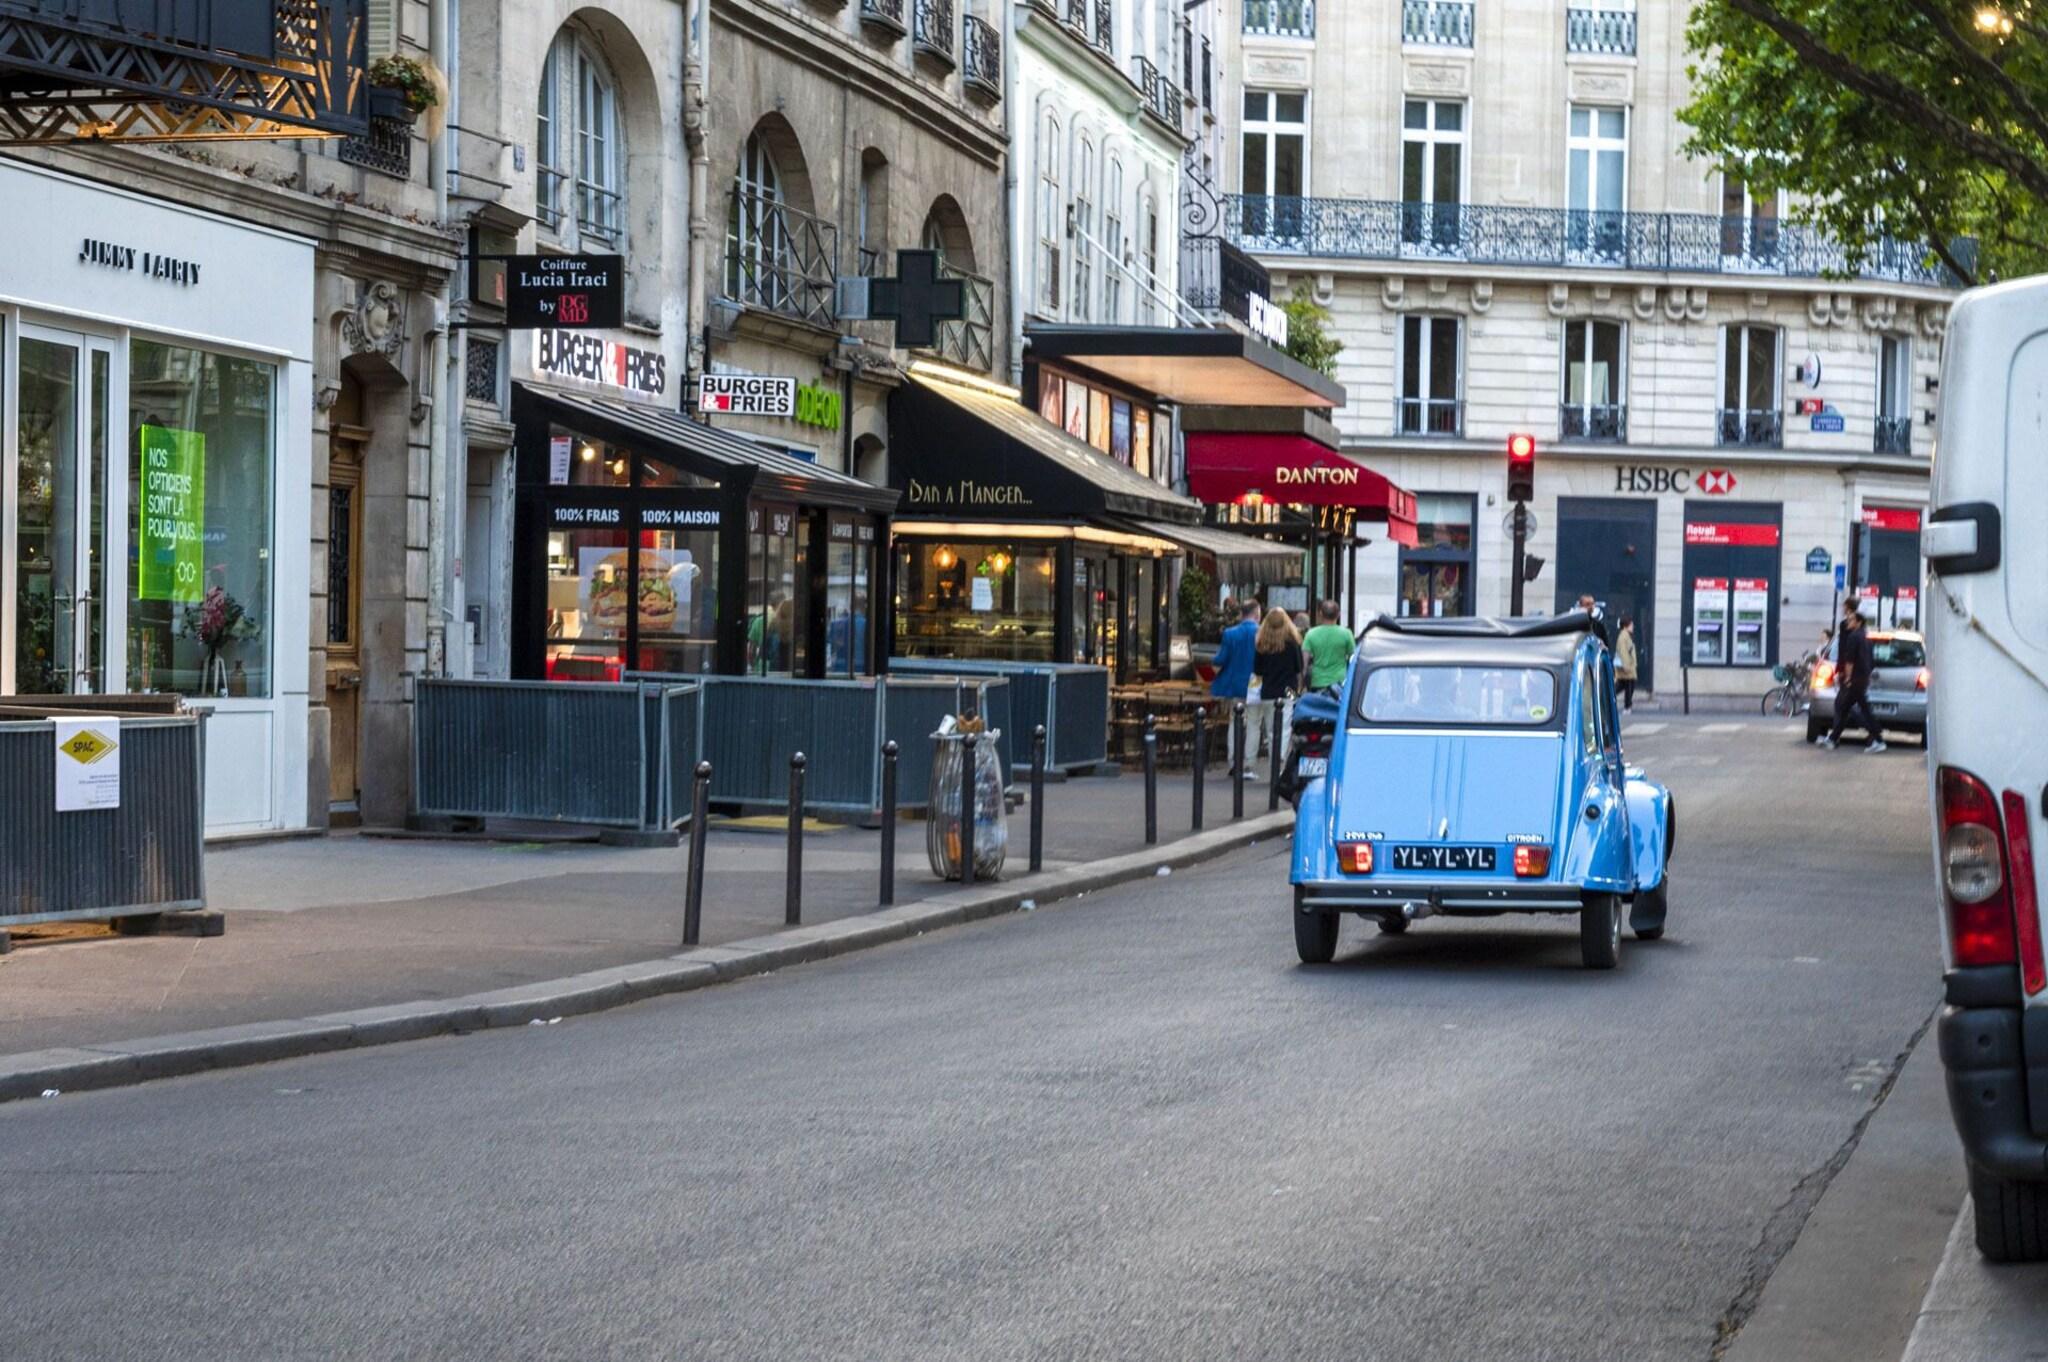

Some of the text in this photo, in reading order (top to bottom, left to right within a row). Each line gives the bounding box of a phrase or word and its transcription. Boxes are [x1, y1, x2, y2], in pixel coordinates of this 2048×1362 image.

[79, 238, 137, 271] JIMMY
[540, 259, 588, 271] Coiffure
[520, 272, 608, 287] Lucia Iraci
[539, 299, 556, 315] by
[539, 328, 604, 382] BURGER
[623, 346, 666, 395] FRIES
[703, 377, 789, 397] BURGER
[703, 394, 789, 412] & FRIES
[148, 447, 168, 468] NOS
[148, 471, 193, 495] OPTICIENS
[1275, 466, 1360, 485] DANTON
[1615, 465, 1691, 494] HSBC
[147, 495, 172, 515] SONT
[554, 508, 620, 523] 100% FRAIS
[641, 510, 721, 525] 100% MAISON
[147, 517, 174, 538] POUR
[73, 741, 95, 753] SPAC
